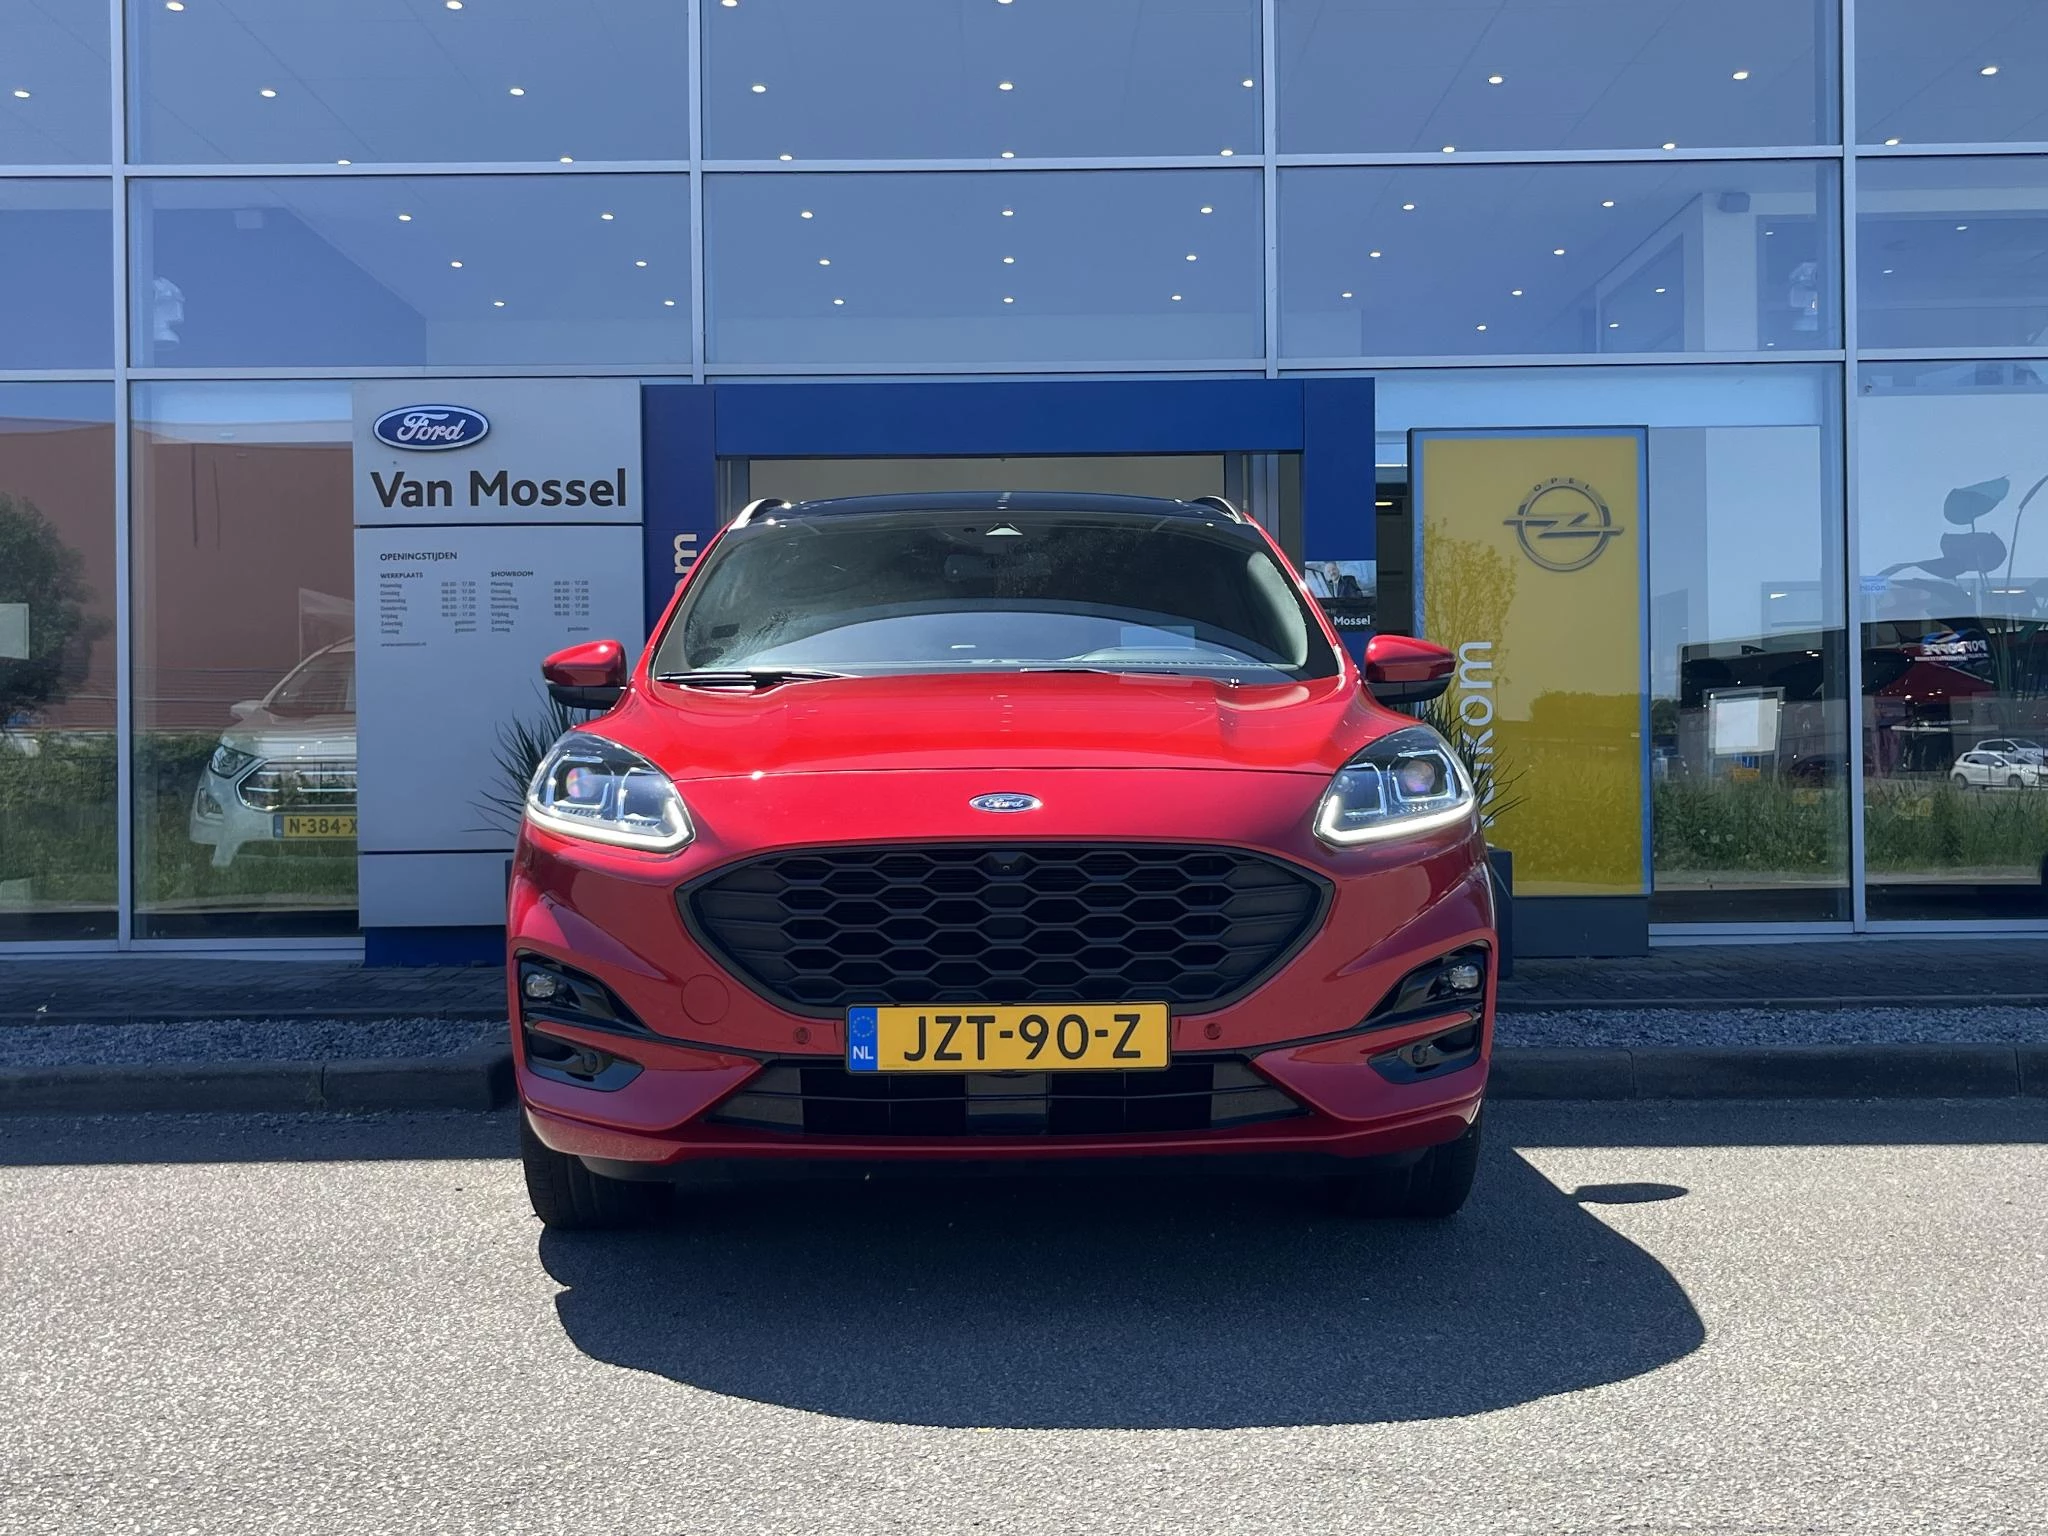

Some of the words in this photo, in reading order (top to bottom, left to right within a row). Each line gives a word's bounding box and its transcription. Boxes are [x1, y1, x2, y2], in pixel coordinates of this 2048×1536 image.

[397, 412, 466, 441] Ford
[370, 471, 453, 508] Van
[470, 468, 627, 507] Mossel
[1533, 477, 1592, 492] OPEL
[379, 552, 458, 561] OPENINGSTIJDEN
[1333, 615, 1371, 626] Mossel
[852, 1046, 874, 1060] NL
[903, 1013, 1142, 1062] JZT-90-Z
